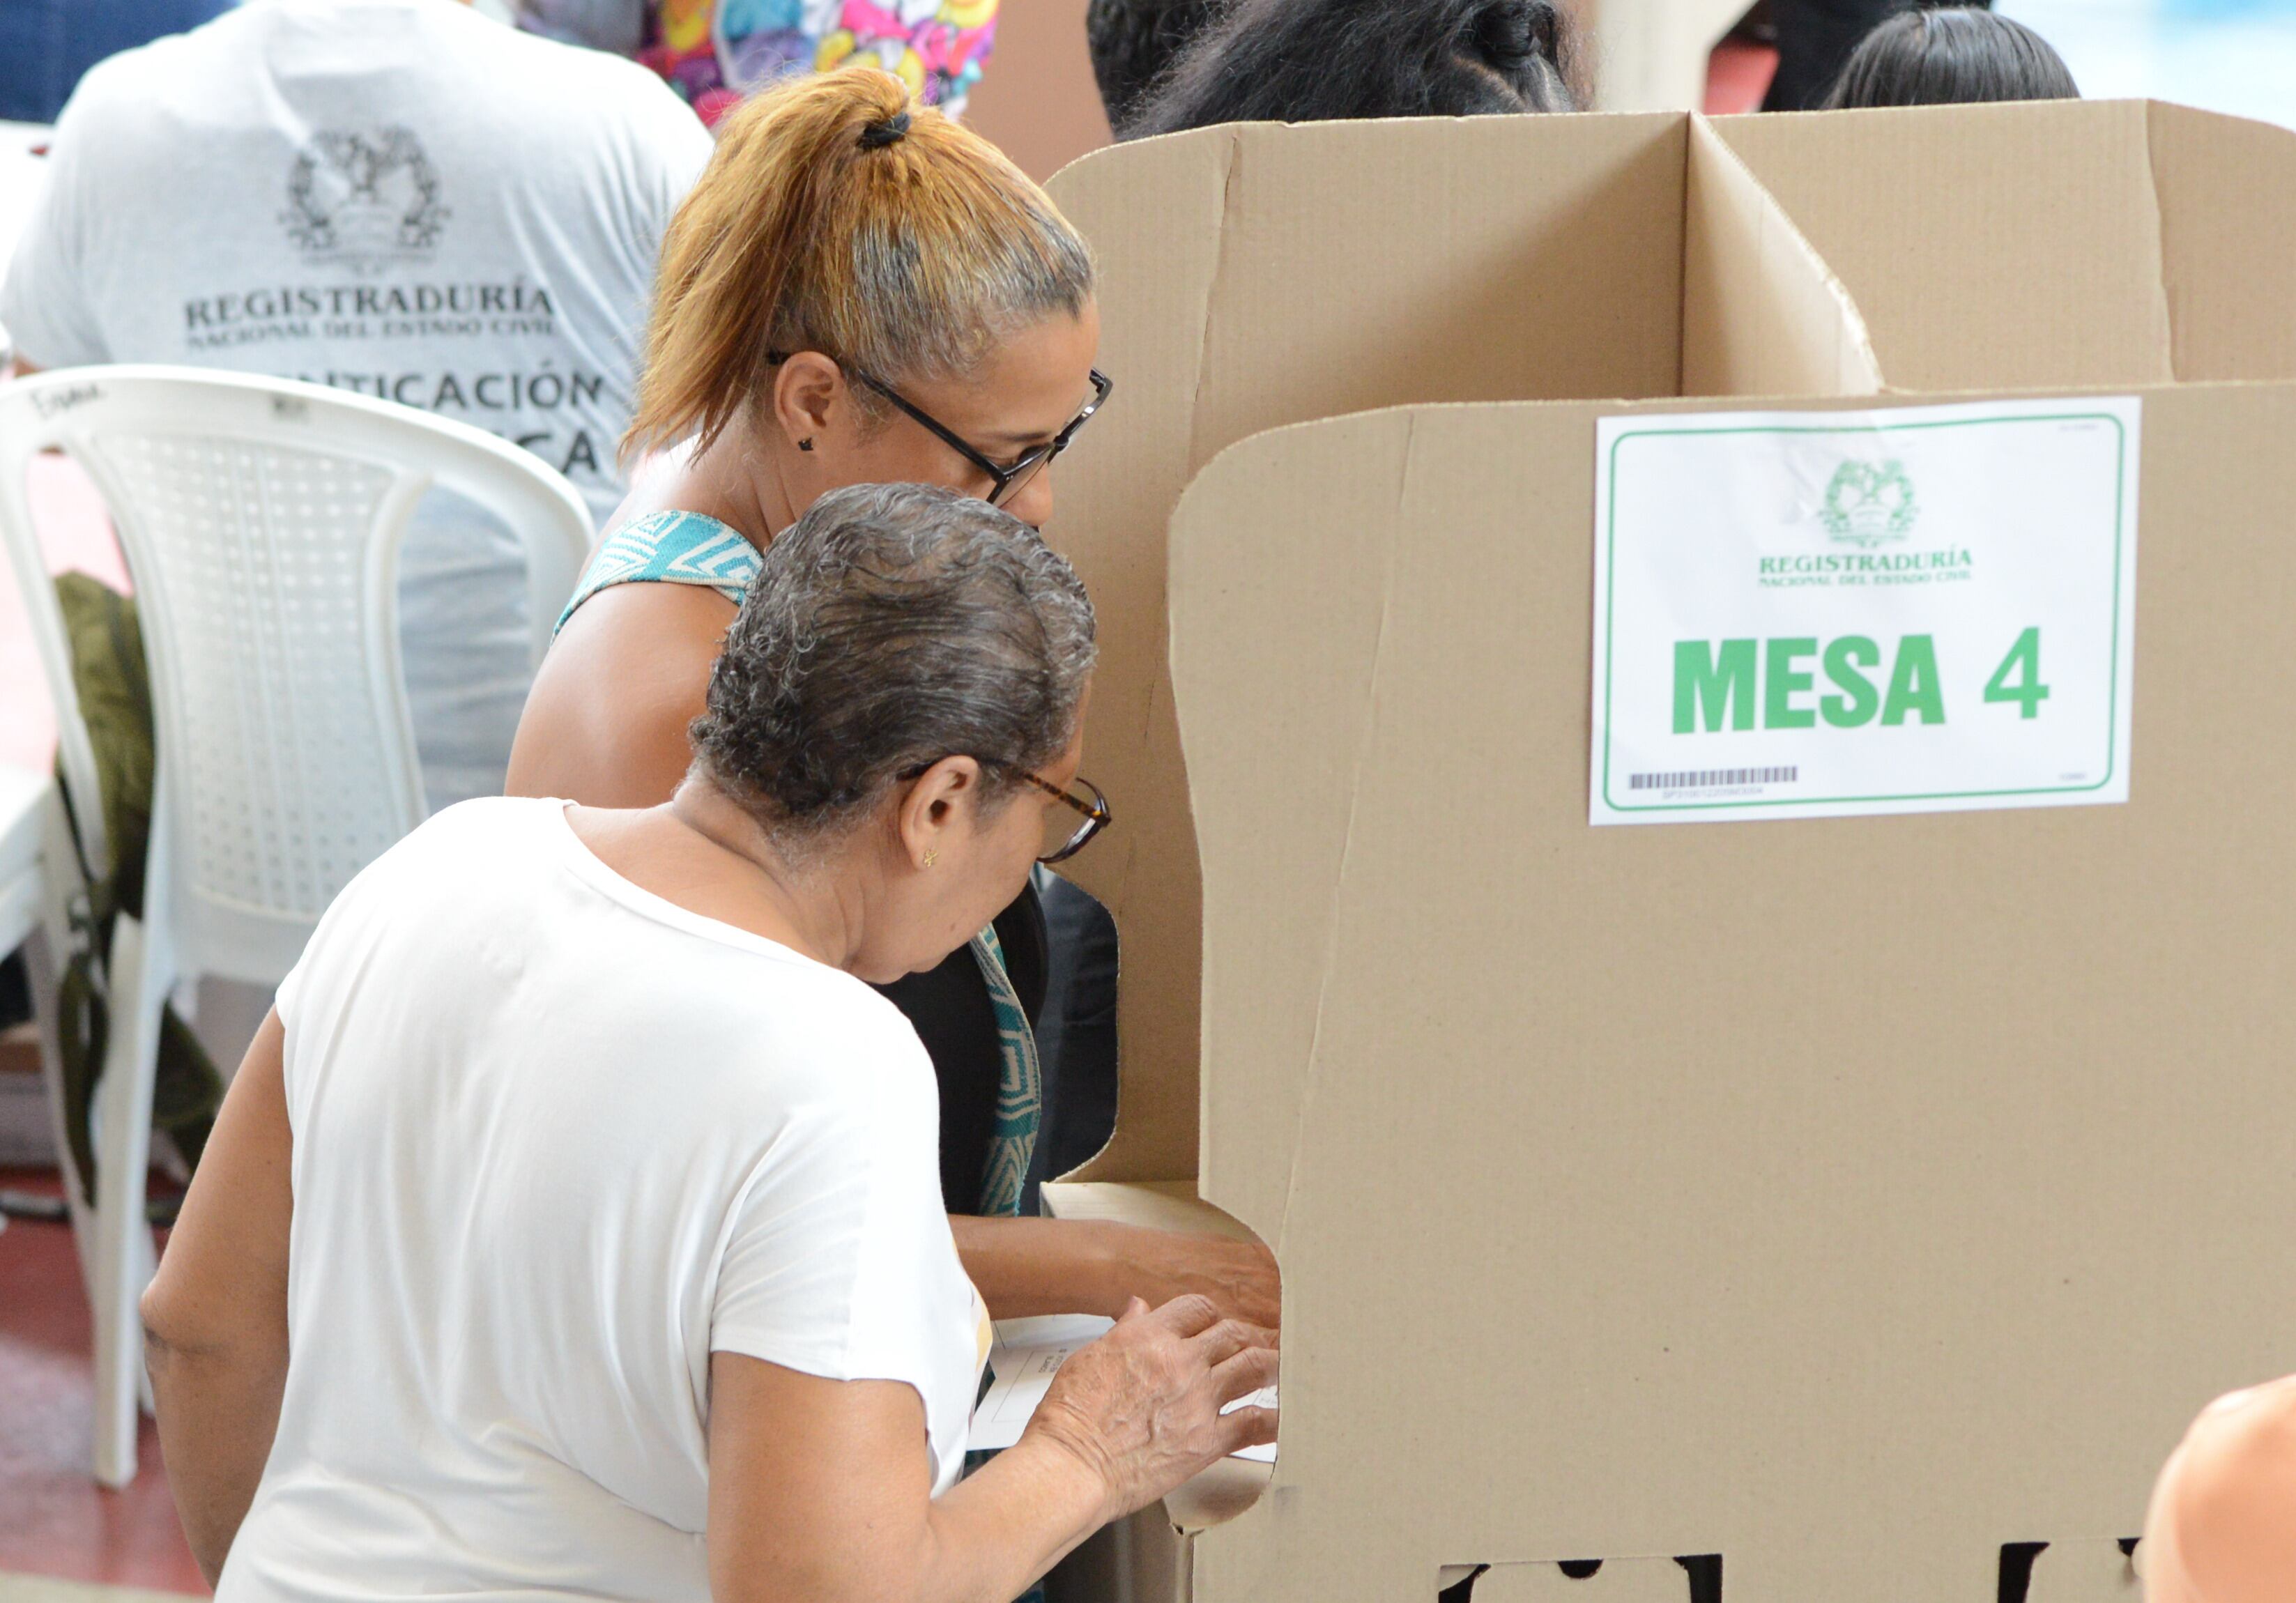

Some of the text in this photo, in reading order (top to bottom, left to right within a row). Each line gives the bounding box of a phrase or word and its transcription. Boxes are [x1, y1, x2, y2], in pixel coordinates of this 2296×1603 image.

[185, 275, 555, 330] REGISTRADURÍA
[1759, 544, 1972, 574] REGISTRADURÍA
[1672, 627, 2050, 734] MESA 4
